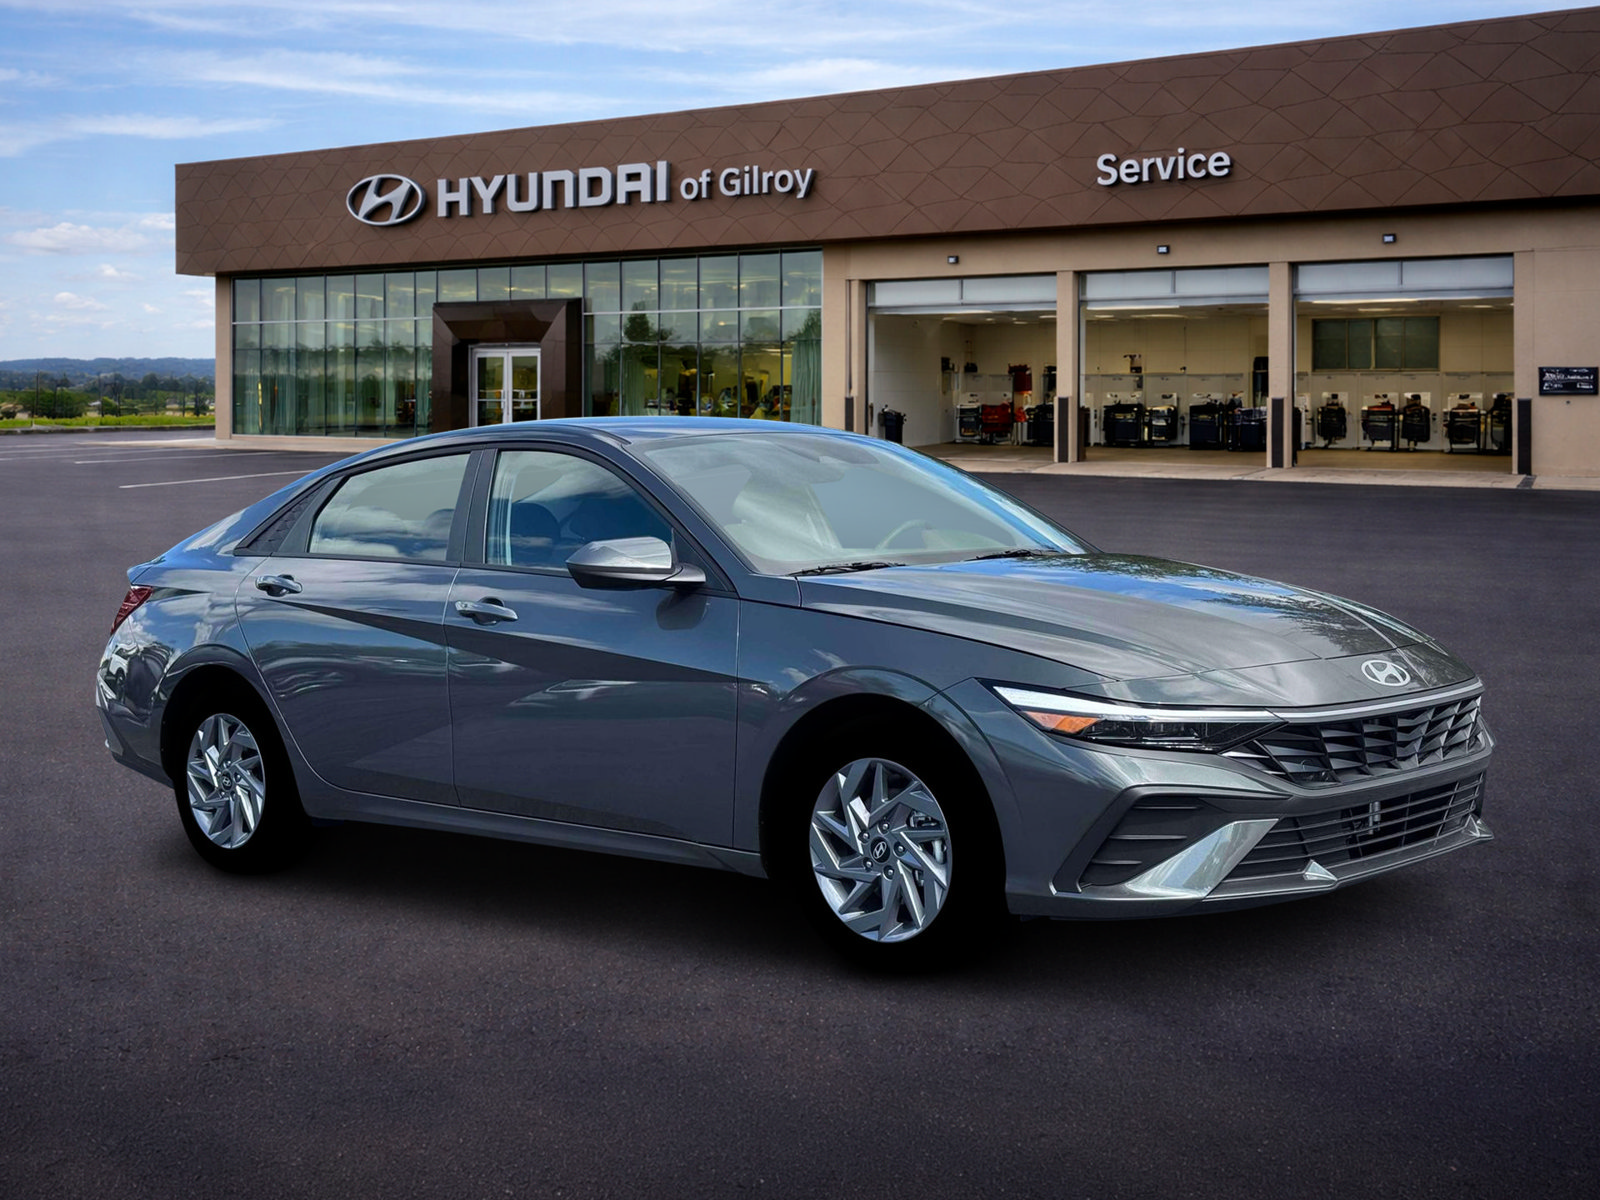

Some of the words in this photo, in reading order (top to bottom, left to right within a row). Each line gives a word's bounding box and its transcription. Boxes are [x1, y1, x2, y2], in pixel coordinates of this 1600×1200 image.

[437, 160, 669, 217] HYUNDAI
[680, 169, 713, 200] of
[719, 165, 813, 199] Gilroy
[1096, 147, 1231, 186] Service
